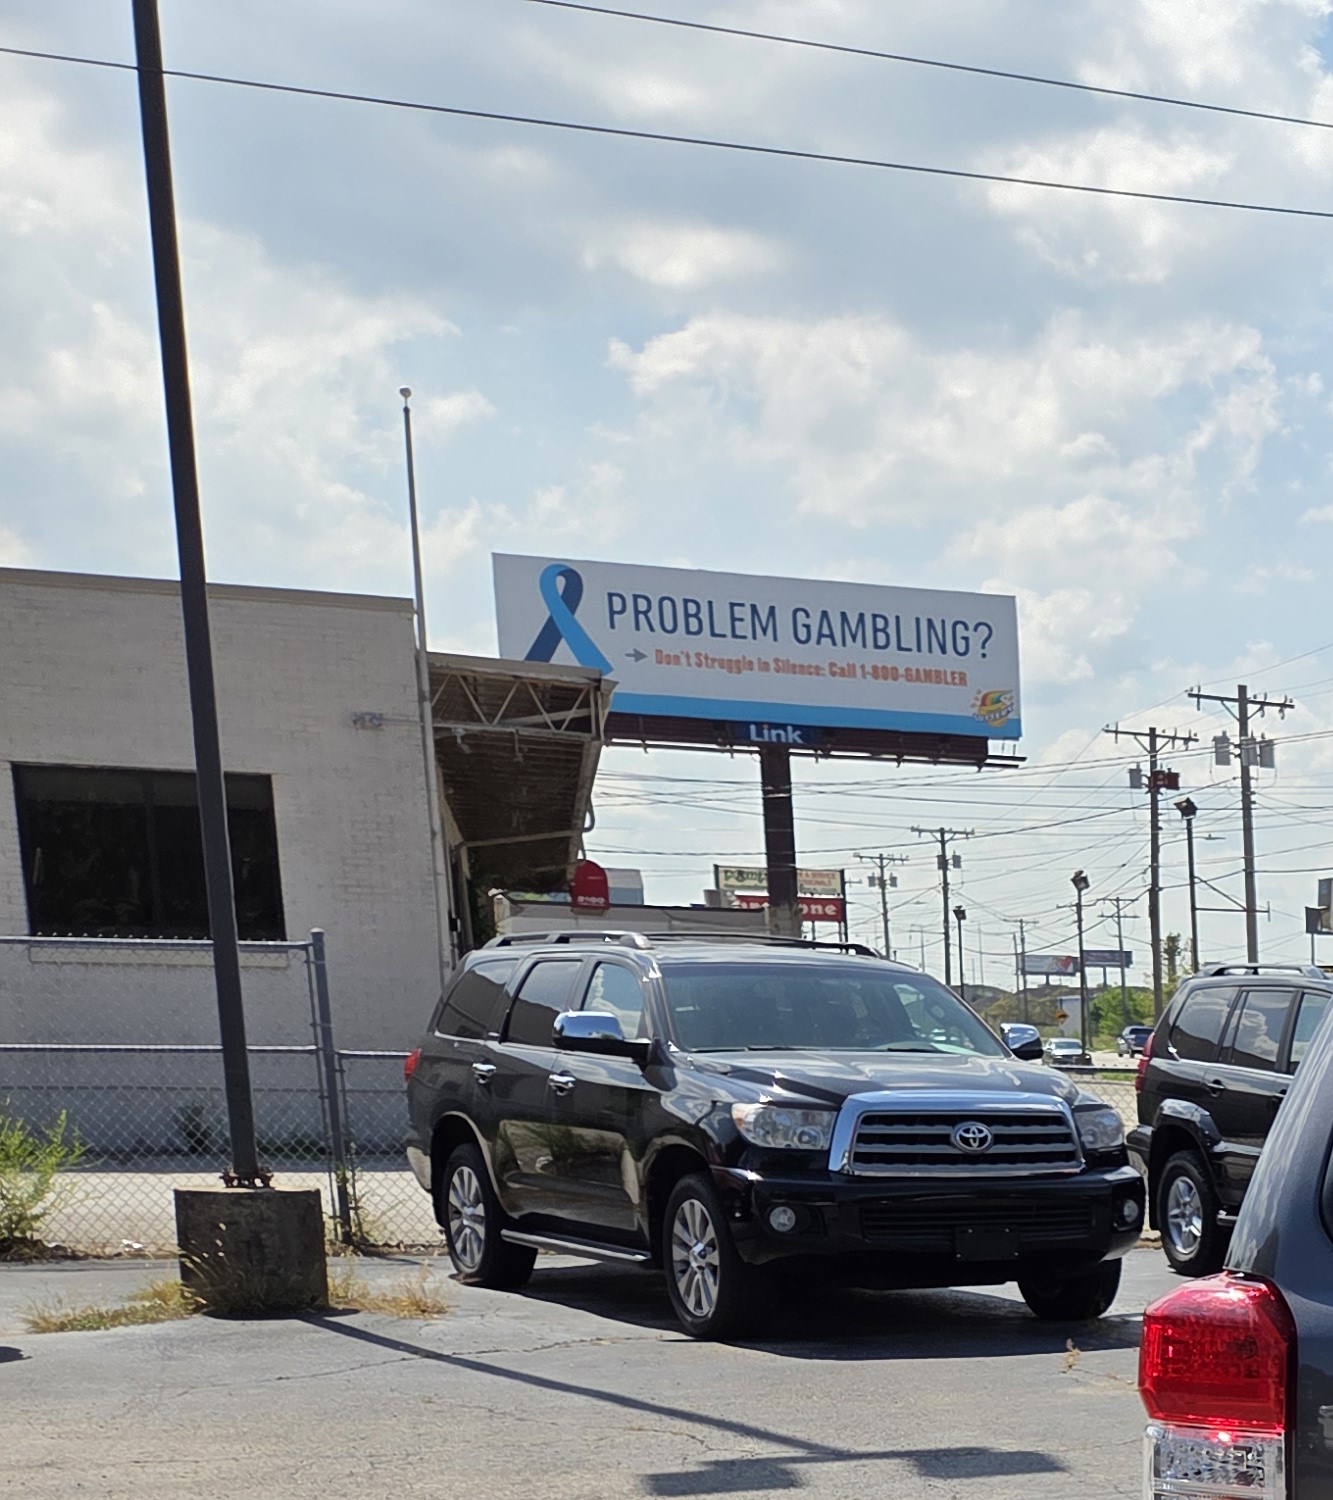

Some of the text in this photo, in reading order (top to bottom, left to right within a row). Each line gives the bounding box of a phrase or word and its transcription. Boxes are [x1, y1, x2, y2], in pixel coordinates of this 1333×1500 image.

[607, 591, 995, 660] PROBLEM GAMBLING?
[655, 648, 969, 687] Don't Struggle in Silence: Call 1-800-GAMBLER
[749, 723, 805, 745] Link
